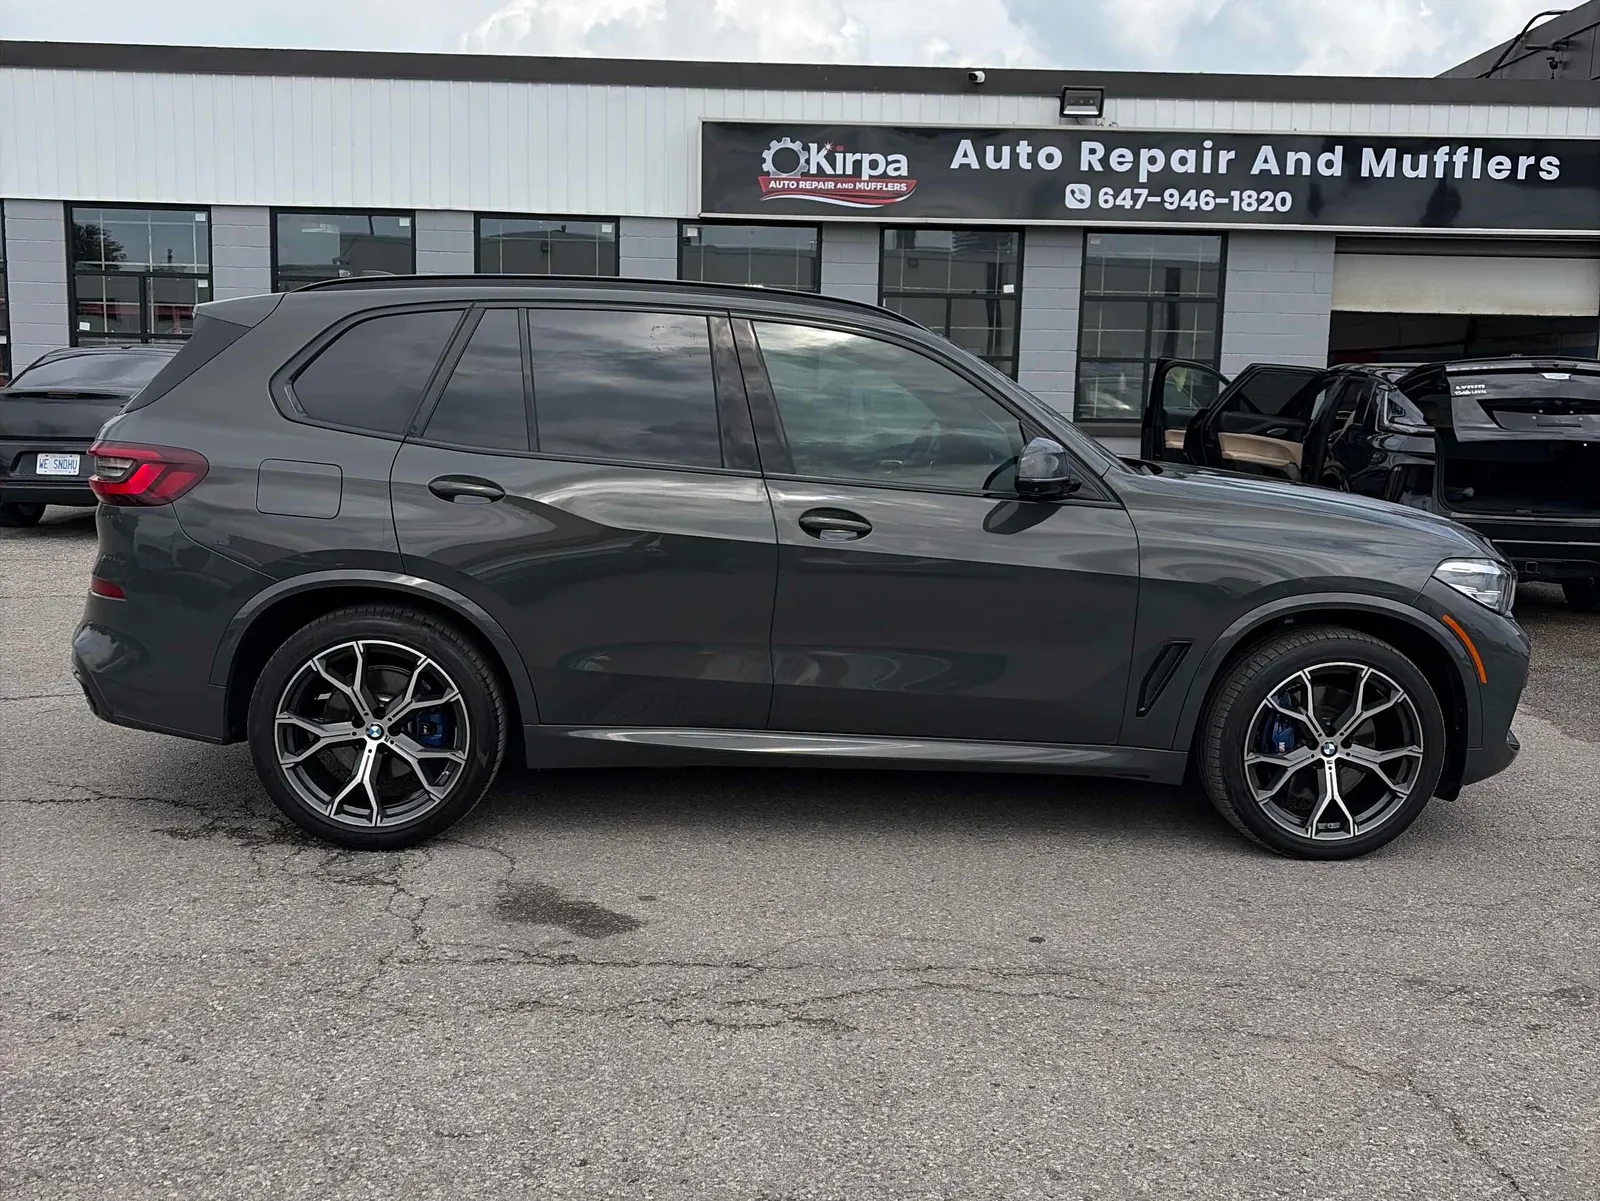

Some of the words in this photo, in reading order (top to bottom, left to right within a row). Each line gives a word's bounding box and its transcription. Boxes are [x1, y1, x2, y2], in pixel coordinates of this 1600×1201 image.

[807, 142, 908, 180] Kirpa
[949, 139, 1062, 170] Auto
[1080, 140, 1235, 182] Repair
[1251, 145, 1343, 176] And
[1361, 146, 1561, 180] Mufflers
[769, 180, 797, 189] AUTO
[799, 181, 835, 189] REPAIR
[855, 182, 907, 191] MUFFLERS
[1098, 187, 1293, 212] 647-946-1820
